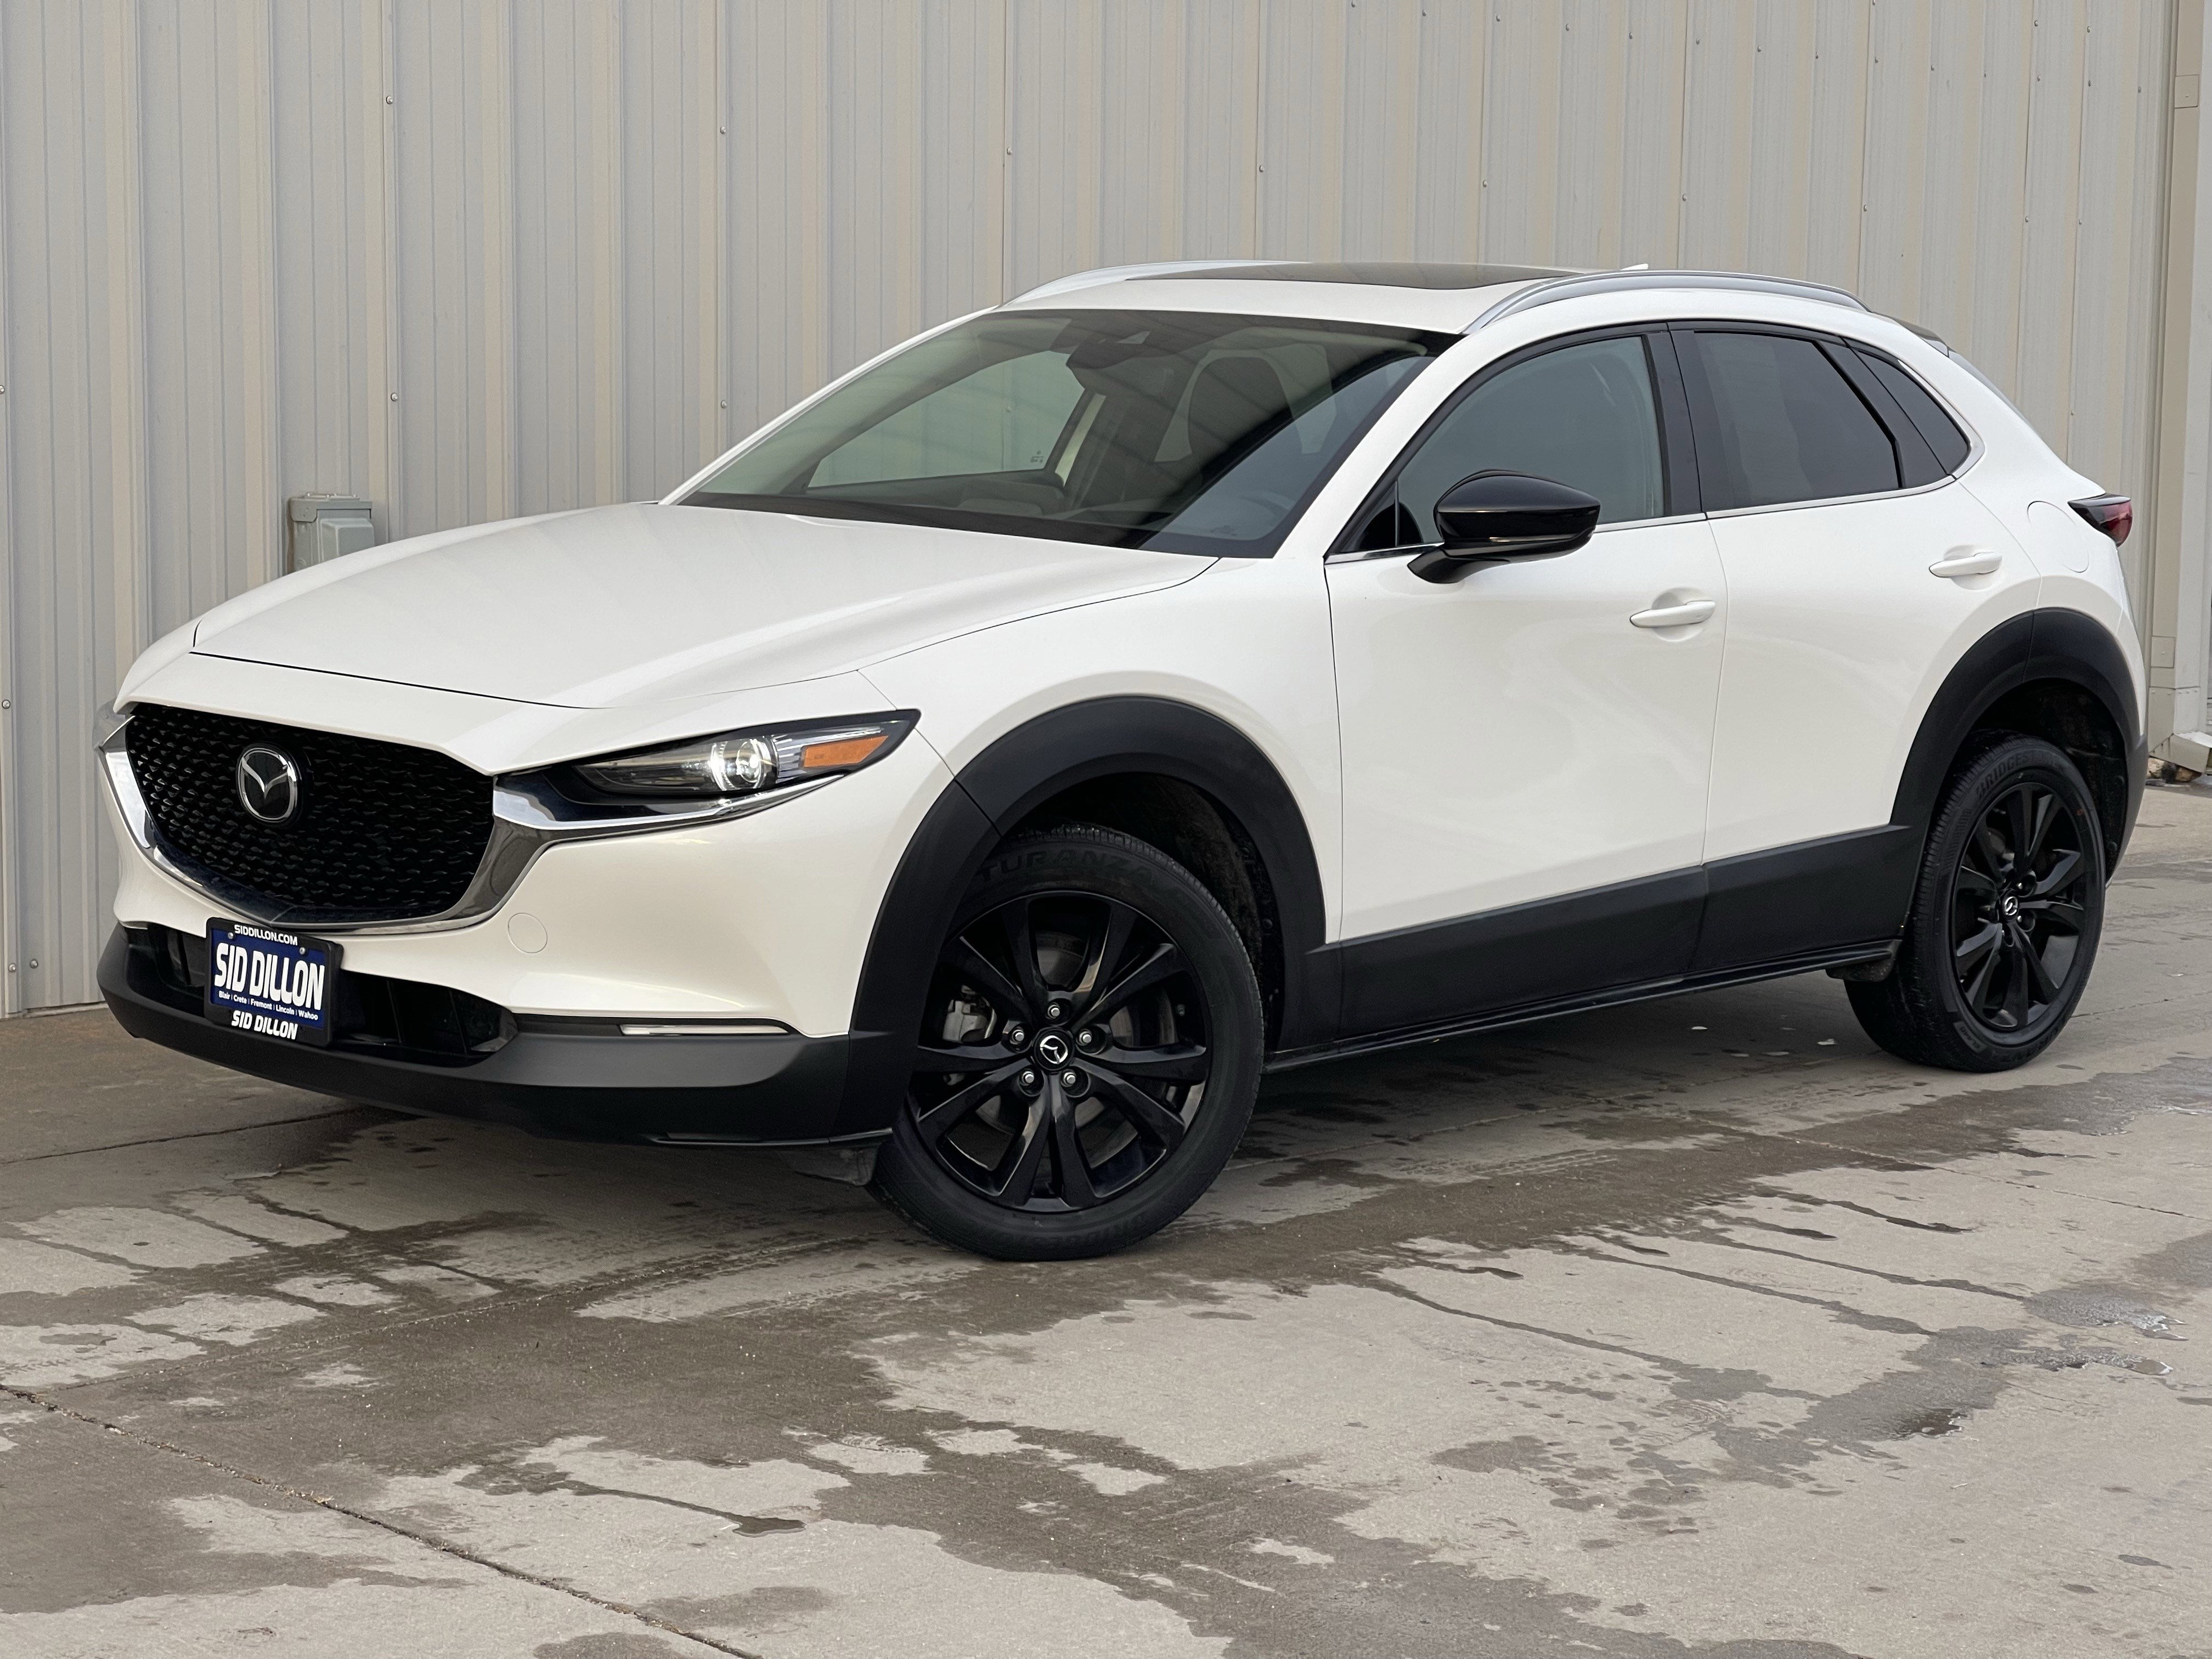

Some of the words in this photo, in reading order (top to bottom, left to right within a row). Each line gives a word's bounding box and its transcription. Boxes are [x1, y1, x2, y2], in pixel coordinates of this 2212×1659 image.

[1976, 749, 2063, 799] BRIDGEST
[976, 848, 1154, 884] TURANZA
[234, 924, 298, 946] SIDDILLON.COM
[214, 942, 247, 992] SID
[249, 950, 325, 1011] DILLON
[218, 991, 230, 1000] Blair
[233, 995, 247, 1004] Crete
[251, 998, 273, 1010] Fremont
[275, 1005, 295, 1015] Lincoln
[298, 1009, 318, 1020] Wahoo
[231, 1010, 252, 1030] SID
[253, 1015, 298, 1040] DILLON
